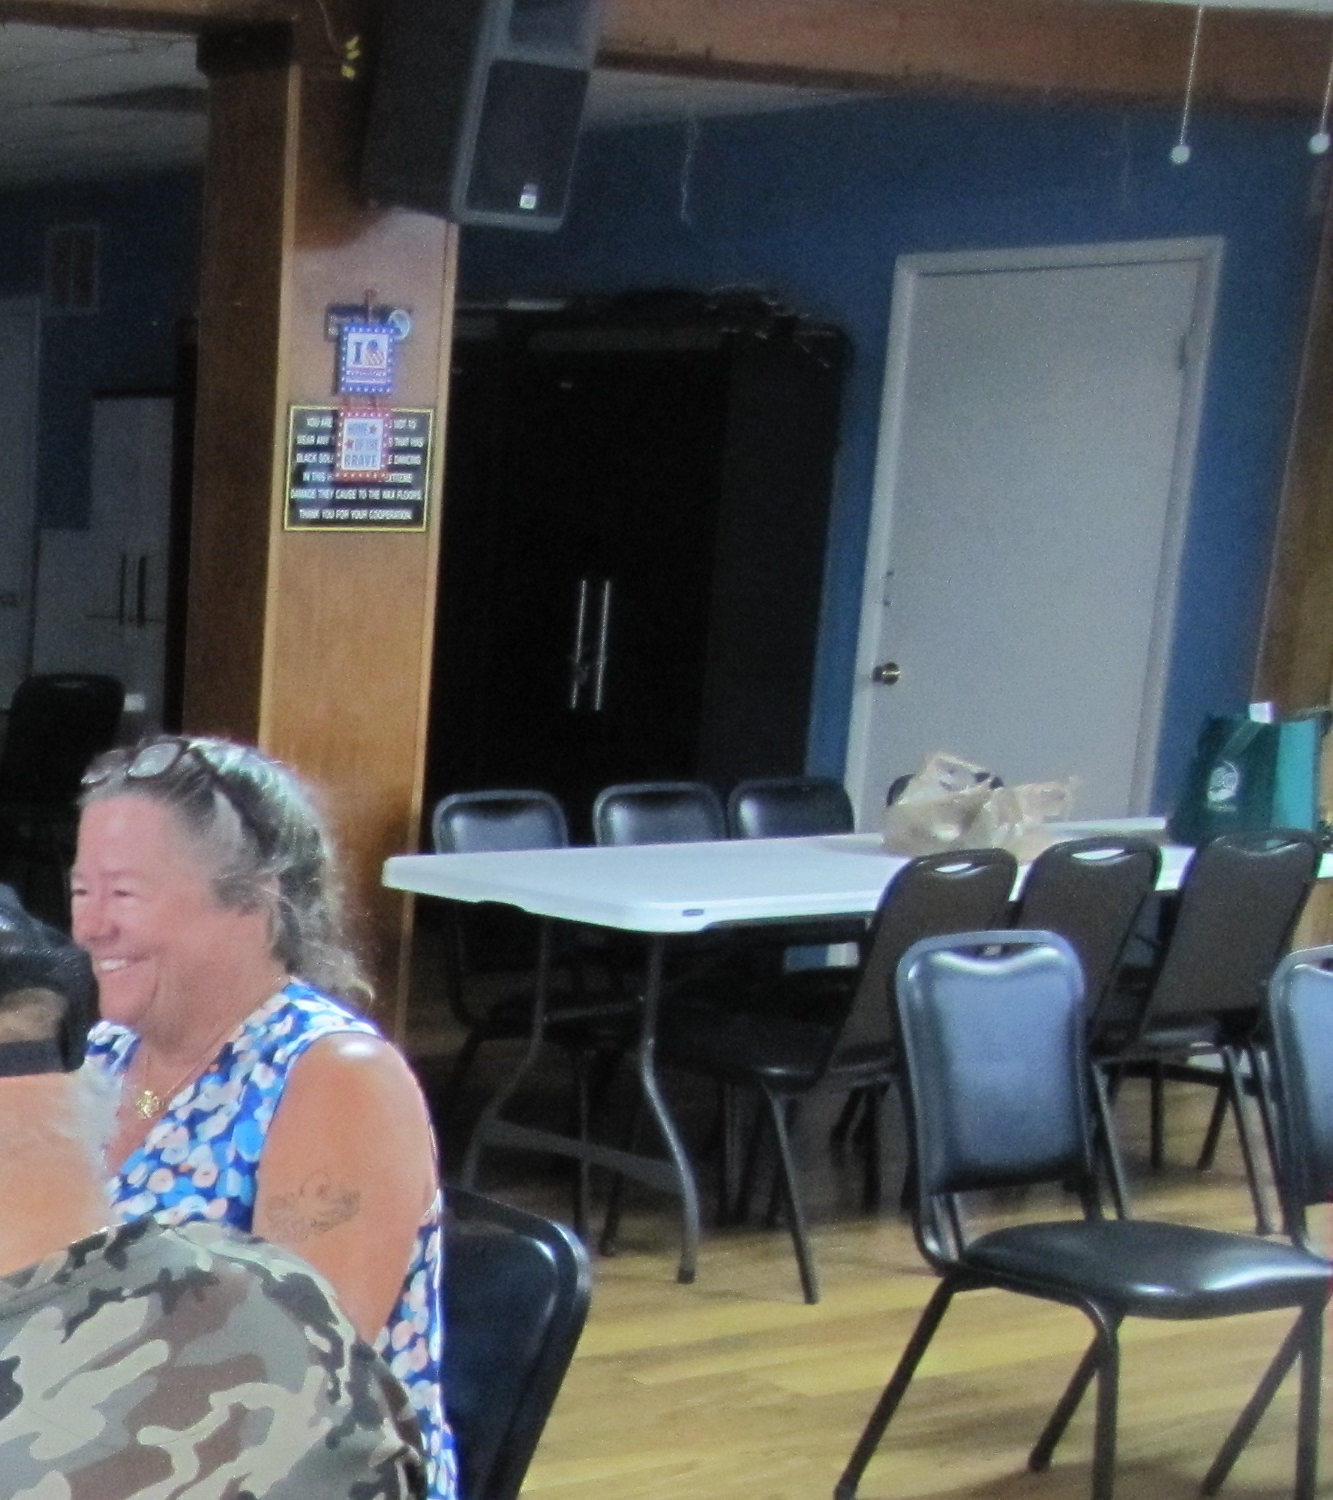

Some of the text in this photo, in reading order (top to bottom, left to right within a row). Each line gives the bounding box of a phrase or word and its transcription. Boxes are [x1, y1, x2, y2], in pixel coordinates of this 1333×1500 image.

[296, 453, 318, 464] BLACK
[345, 453, 377, 468] BRAVE
[335, 489, 358, 500] CAUSE
[358, 489, 368, 500] TO
[368, 490, 381, 500] THE
[299, 509, 321, 520] THANK
[322, 509, 335, 520] YOU
[335, 509, 349, 520] FOR
[350, 510, 368, 520] YOUR
